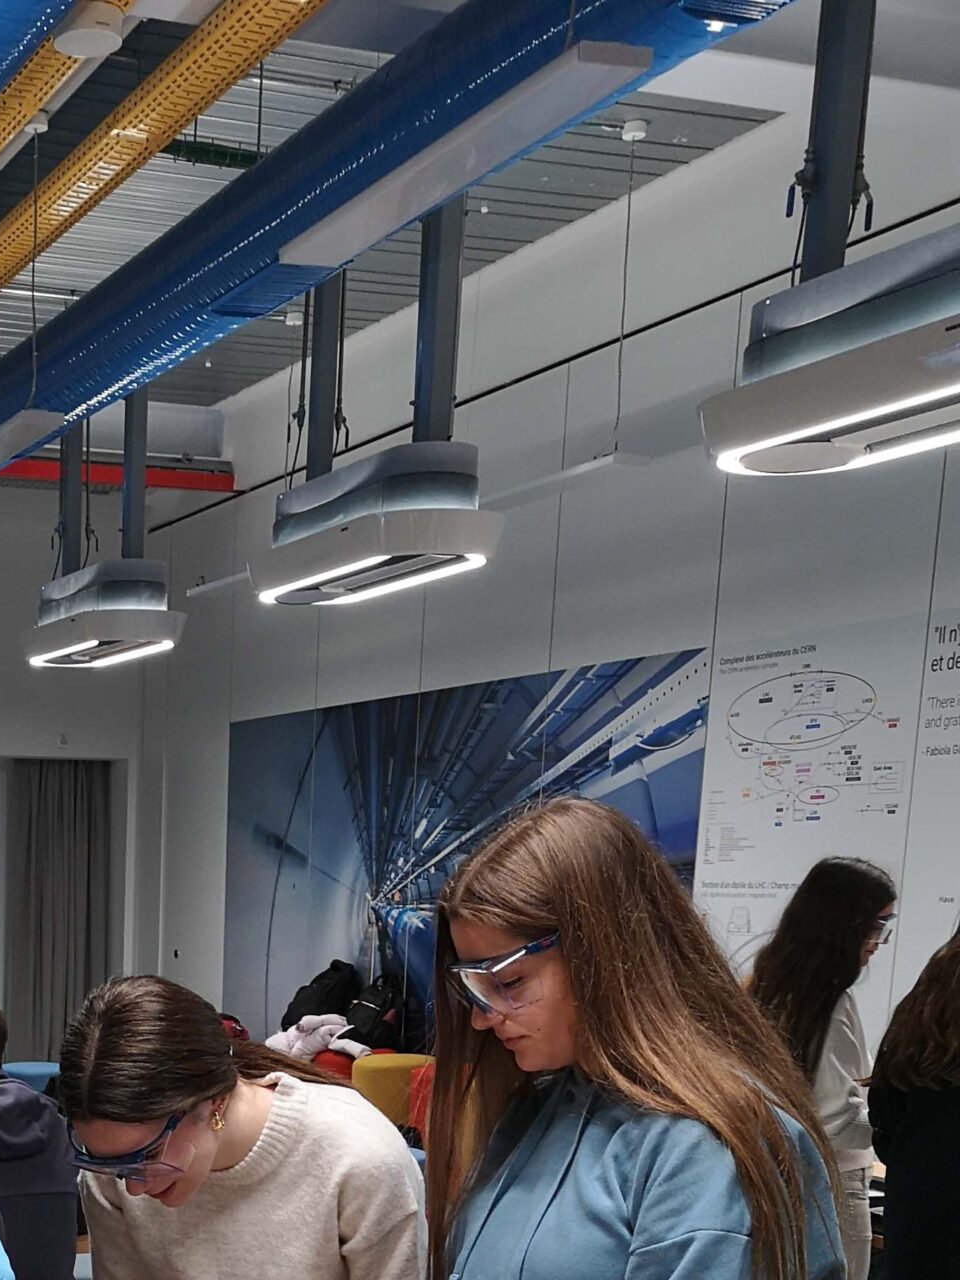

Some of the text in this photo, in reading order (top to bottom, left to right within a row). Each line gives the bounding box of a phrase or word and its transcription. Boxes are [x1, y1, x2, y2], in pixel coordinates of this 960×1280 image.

[800, 643, 817, 654] CERN
[930, 655, 944, 672] et
[924, 715, 942, 729] and
[925, 745, 952, 757] Fabiola
